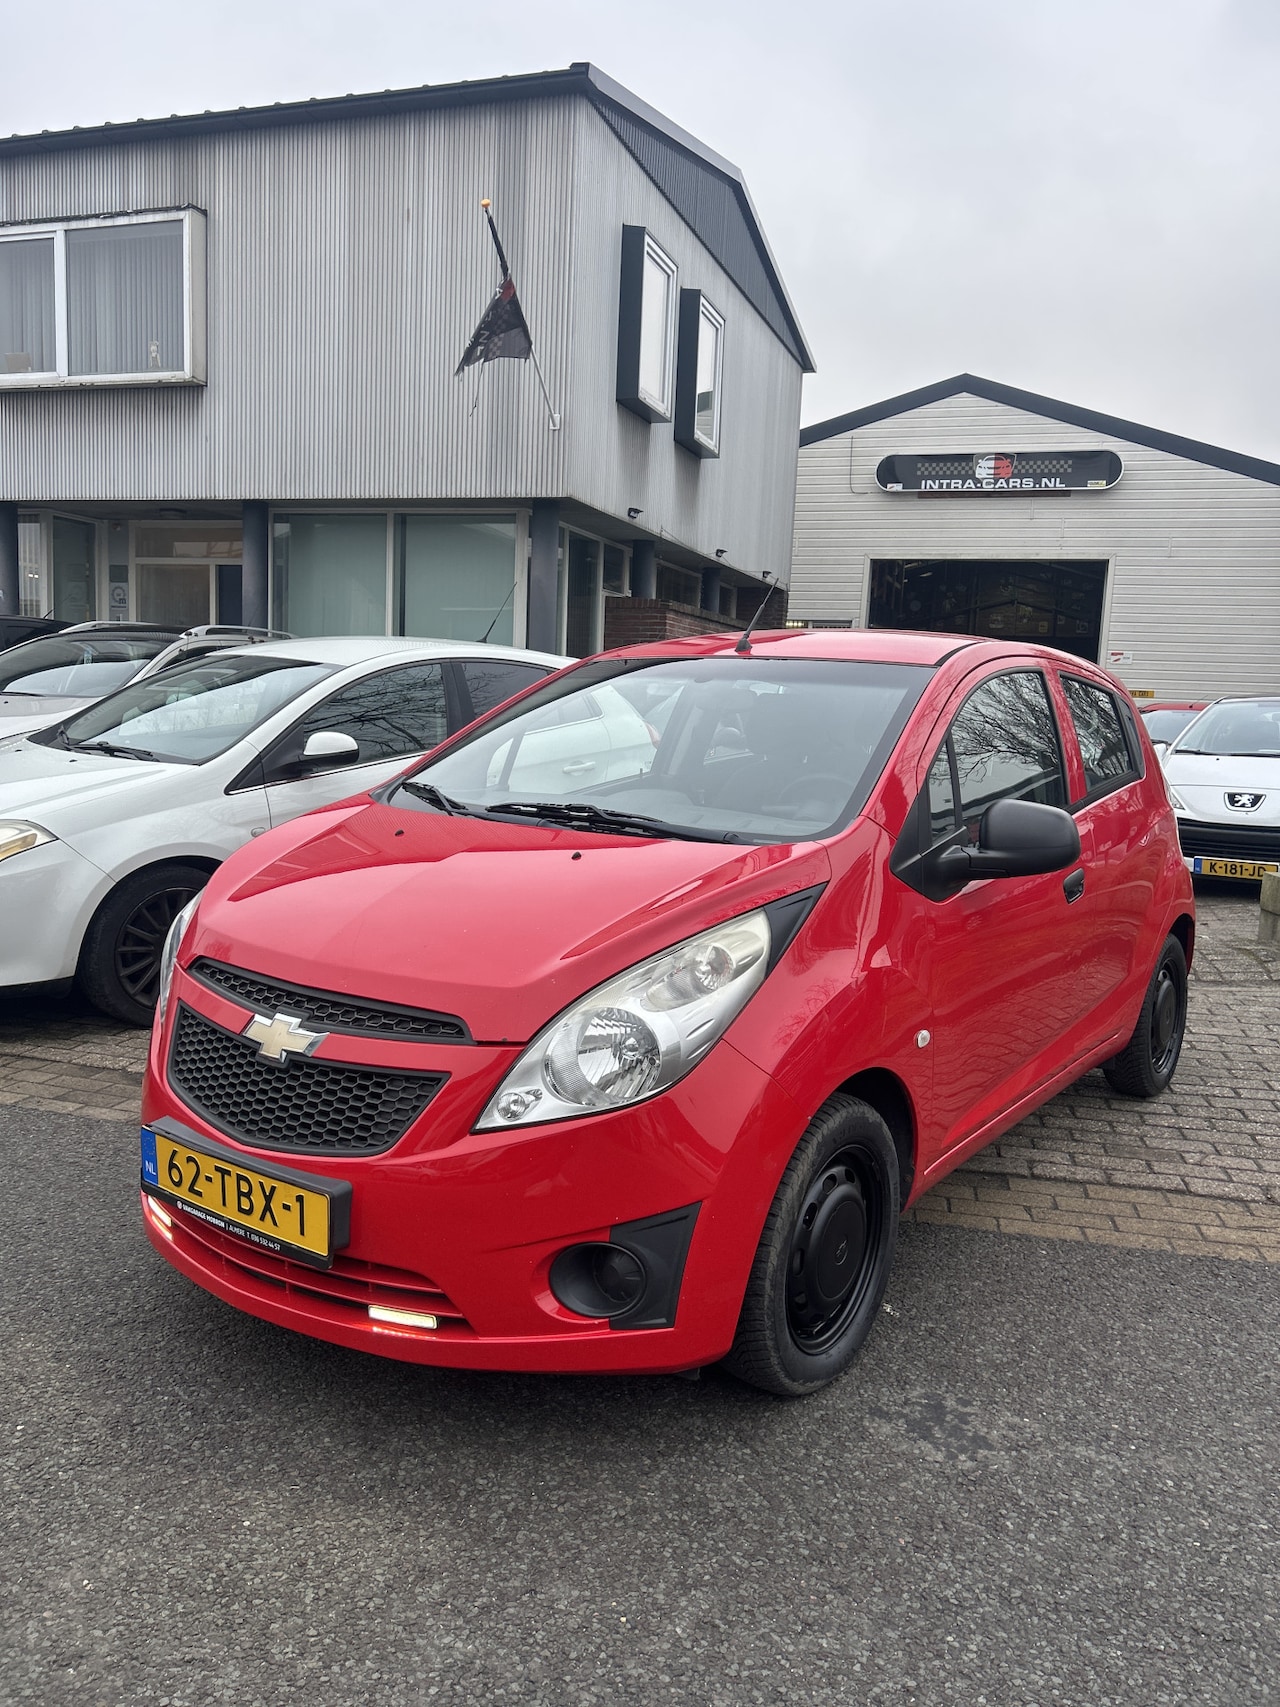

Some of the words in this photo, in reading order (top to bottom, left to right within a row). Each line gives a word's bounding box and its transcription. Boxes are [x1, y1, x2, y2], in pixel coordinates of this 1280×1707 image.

[921, 477, 1066, 490] INTRA-CARS.NL
[1209, 862, 1267, 877] K-181-JD
[145, 1160, 157, 1176] NL
[168, 1148, 305, 1237] 62-TBX-1
